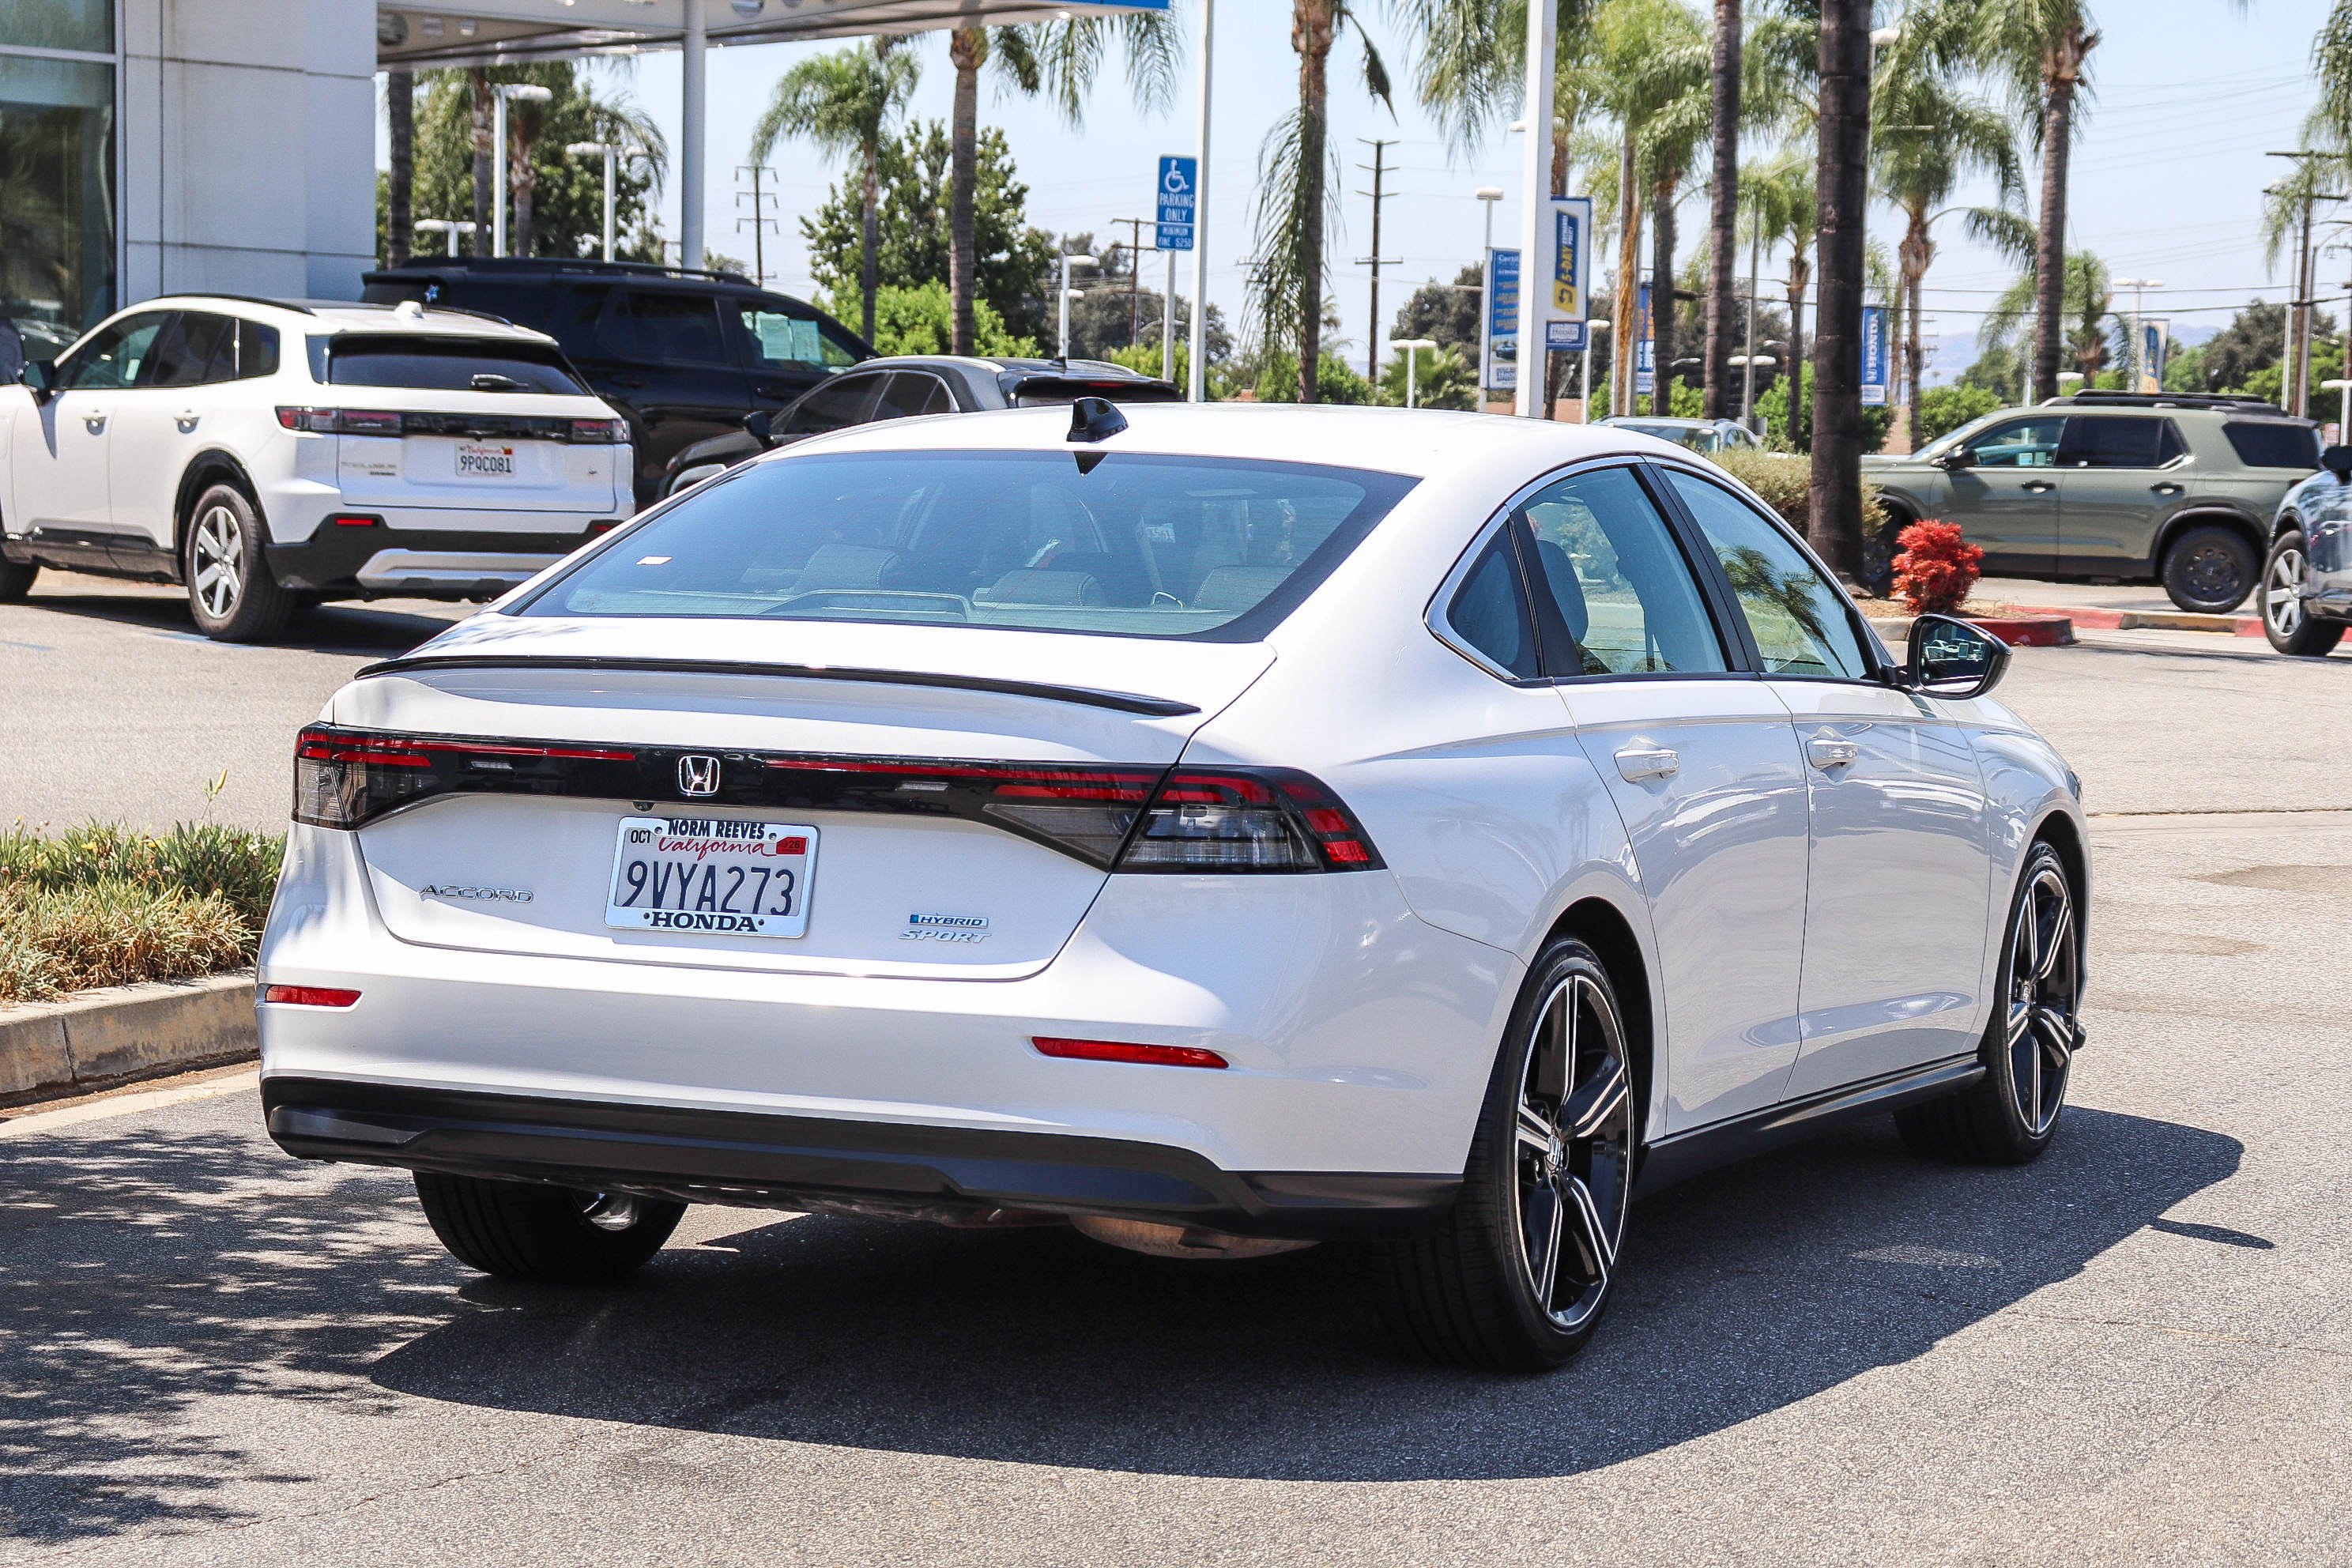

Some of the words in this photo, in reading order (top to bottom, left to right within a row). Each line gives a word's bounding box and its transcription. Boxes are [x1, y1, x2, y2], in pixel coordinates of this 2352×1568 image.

[1159, 192, 1195, 208] PARKING
[1164, 208, 1187, 221] ONLY
[460, 455, 512, 473] 9PQC081
[630, 830, 651, 844] OCT
[667, 819, 710, 838] NORM
[714, 820, 765, 840] REEVES
[658, 835, 778, 861] California
[420, 884, 535, 904] ACCORD
[621, 860, 795, 917] 9VYA273
[649, 910, 760, 933] HONDA
[920, 915, 984, 927] HYBRID
[898, 928, 993, 944] SPORT
